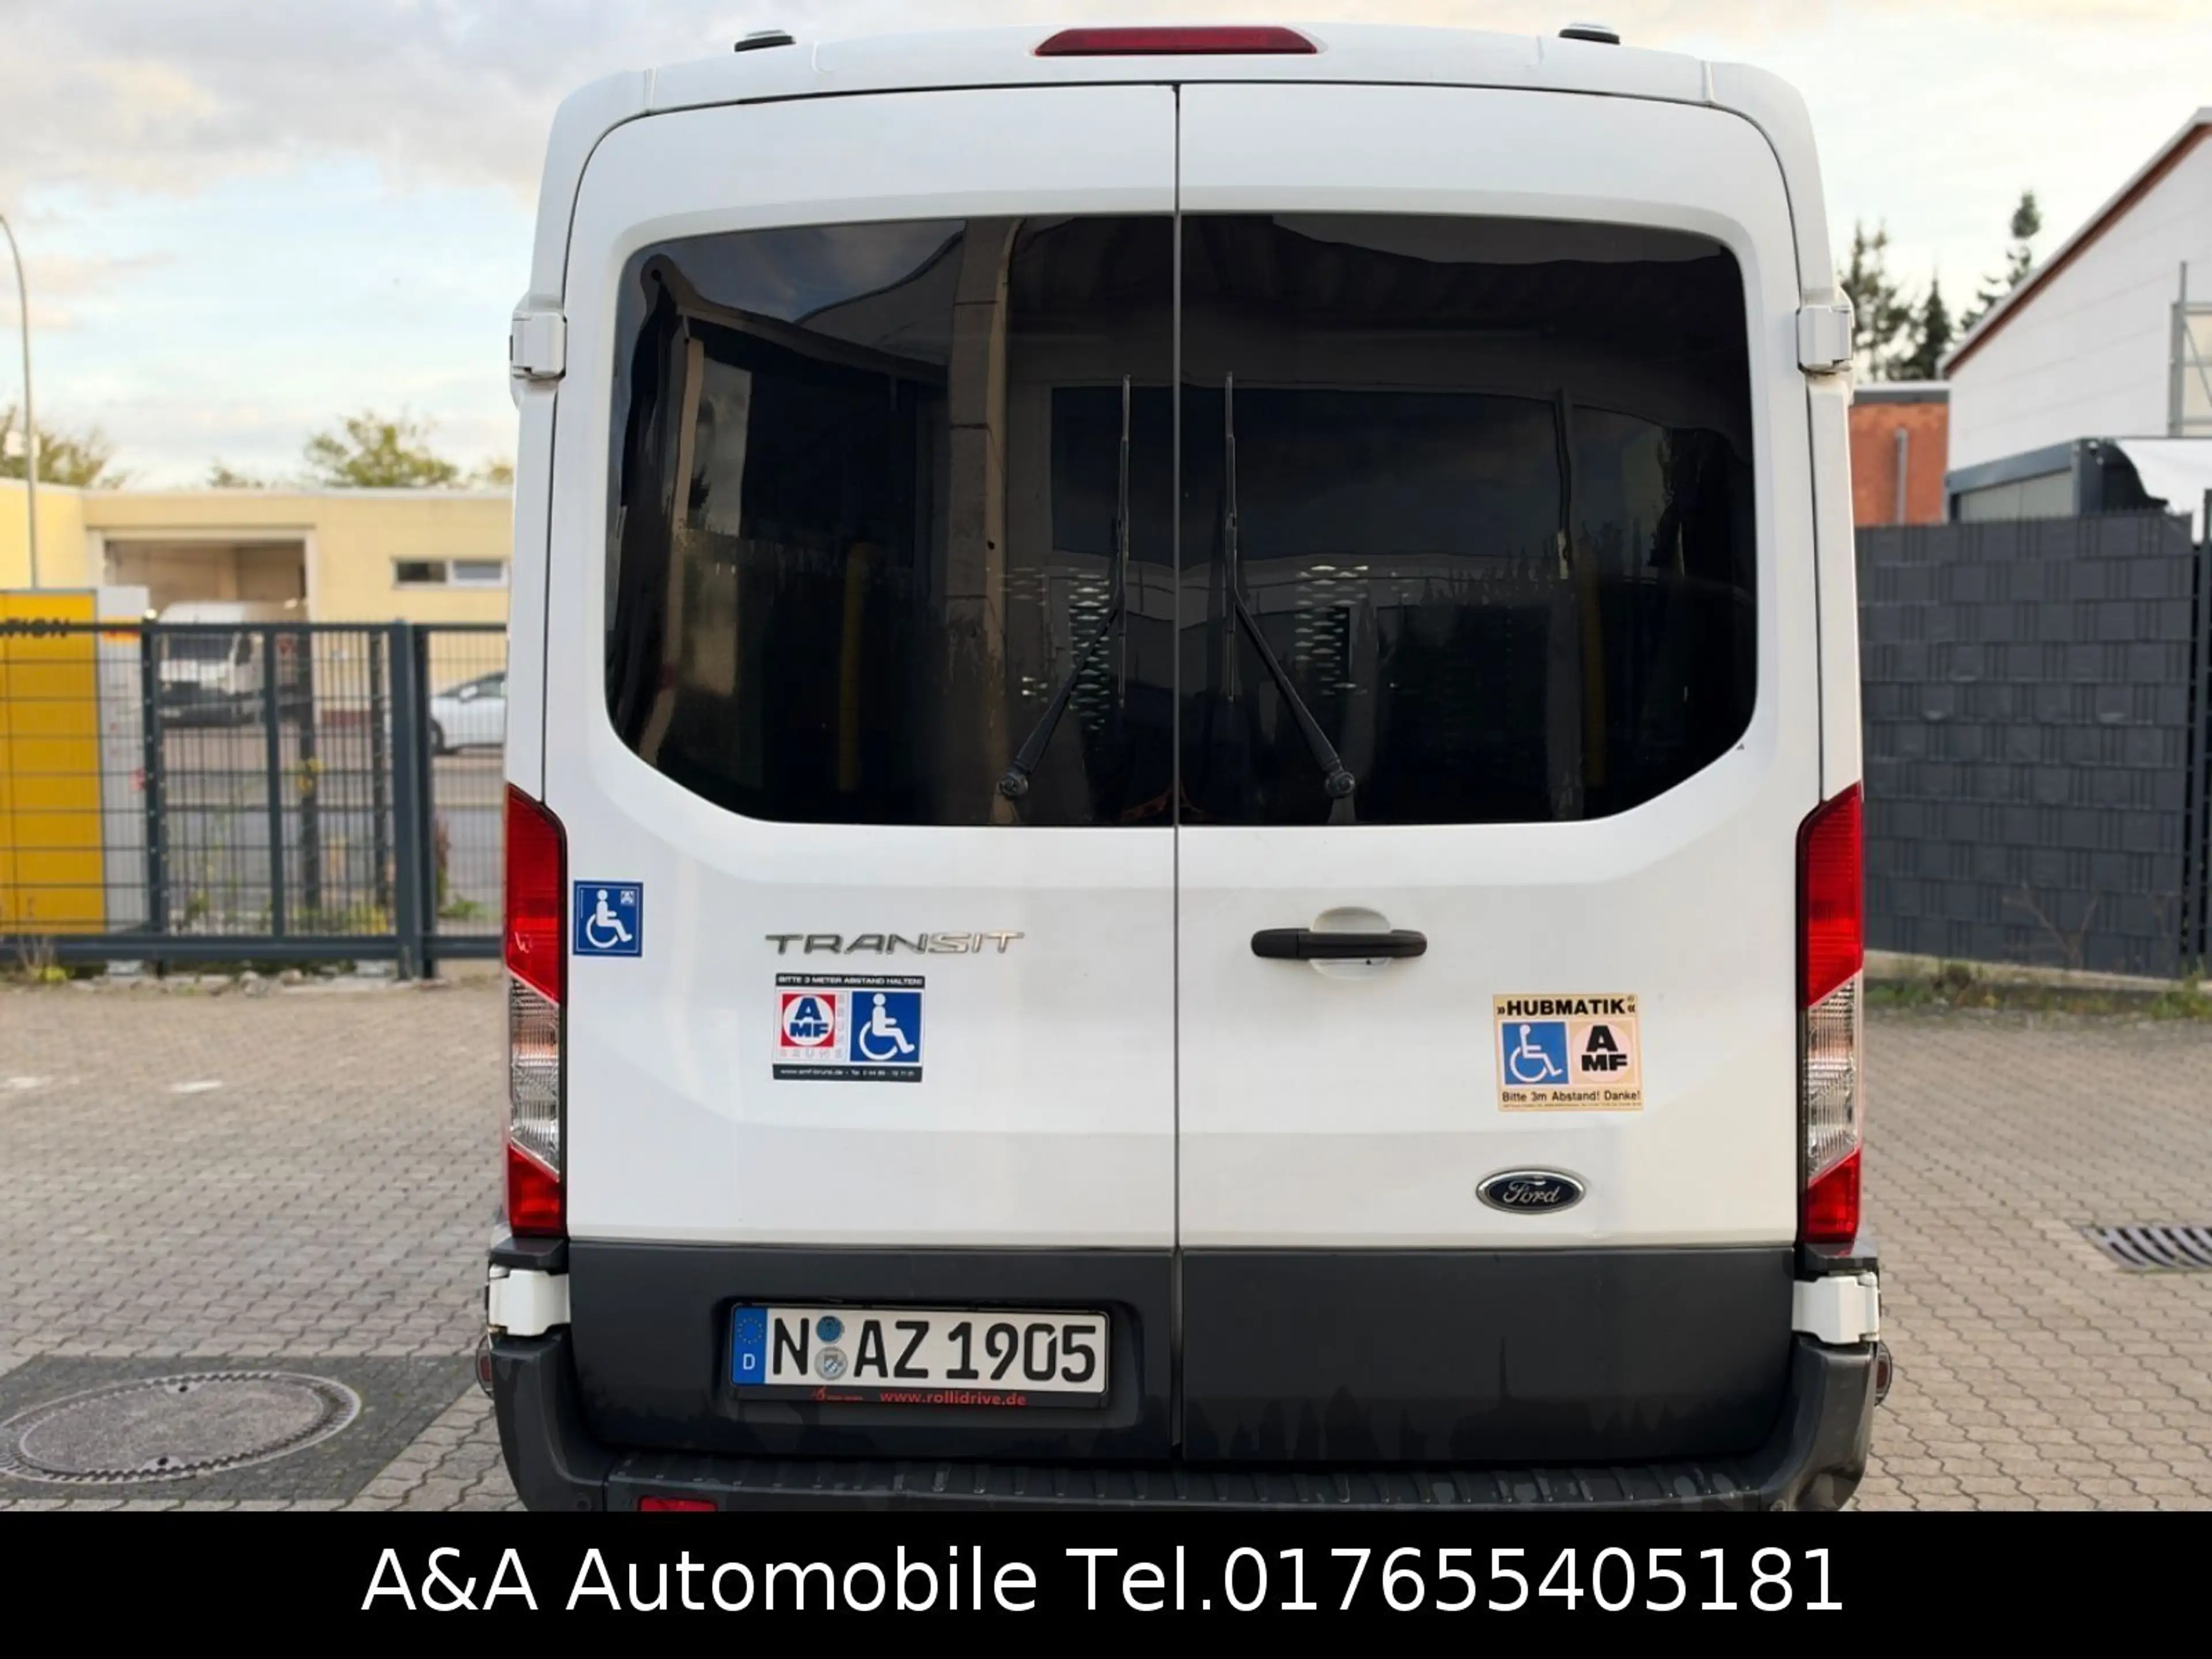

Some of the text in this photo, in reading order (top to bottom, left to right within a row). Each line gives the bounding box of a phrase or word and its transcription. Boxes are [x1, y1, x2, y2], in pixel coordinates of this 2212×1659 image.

[765, 931, 1024, 955] TRANSIT
[1502, 1090, 1641, 1102] Bitte 3m Abstand! Danke!
[1503, 1180, 1560, 1203] Ford
[772, 1318, 1096, 1383] N AZ 1905
[743, 1354, 755, 1370] D
[880, 1390, 1027, 1406] www.rollidrive.de
